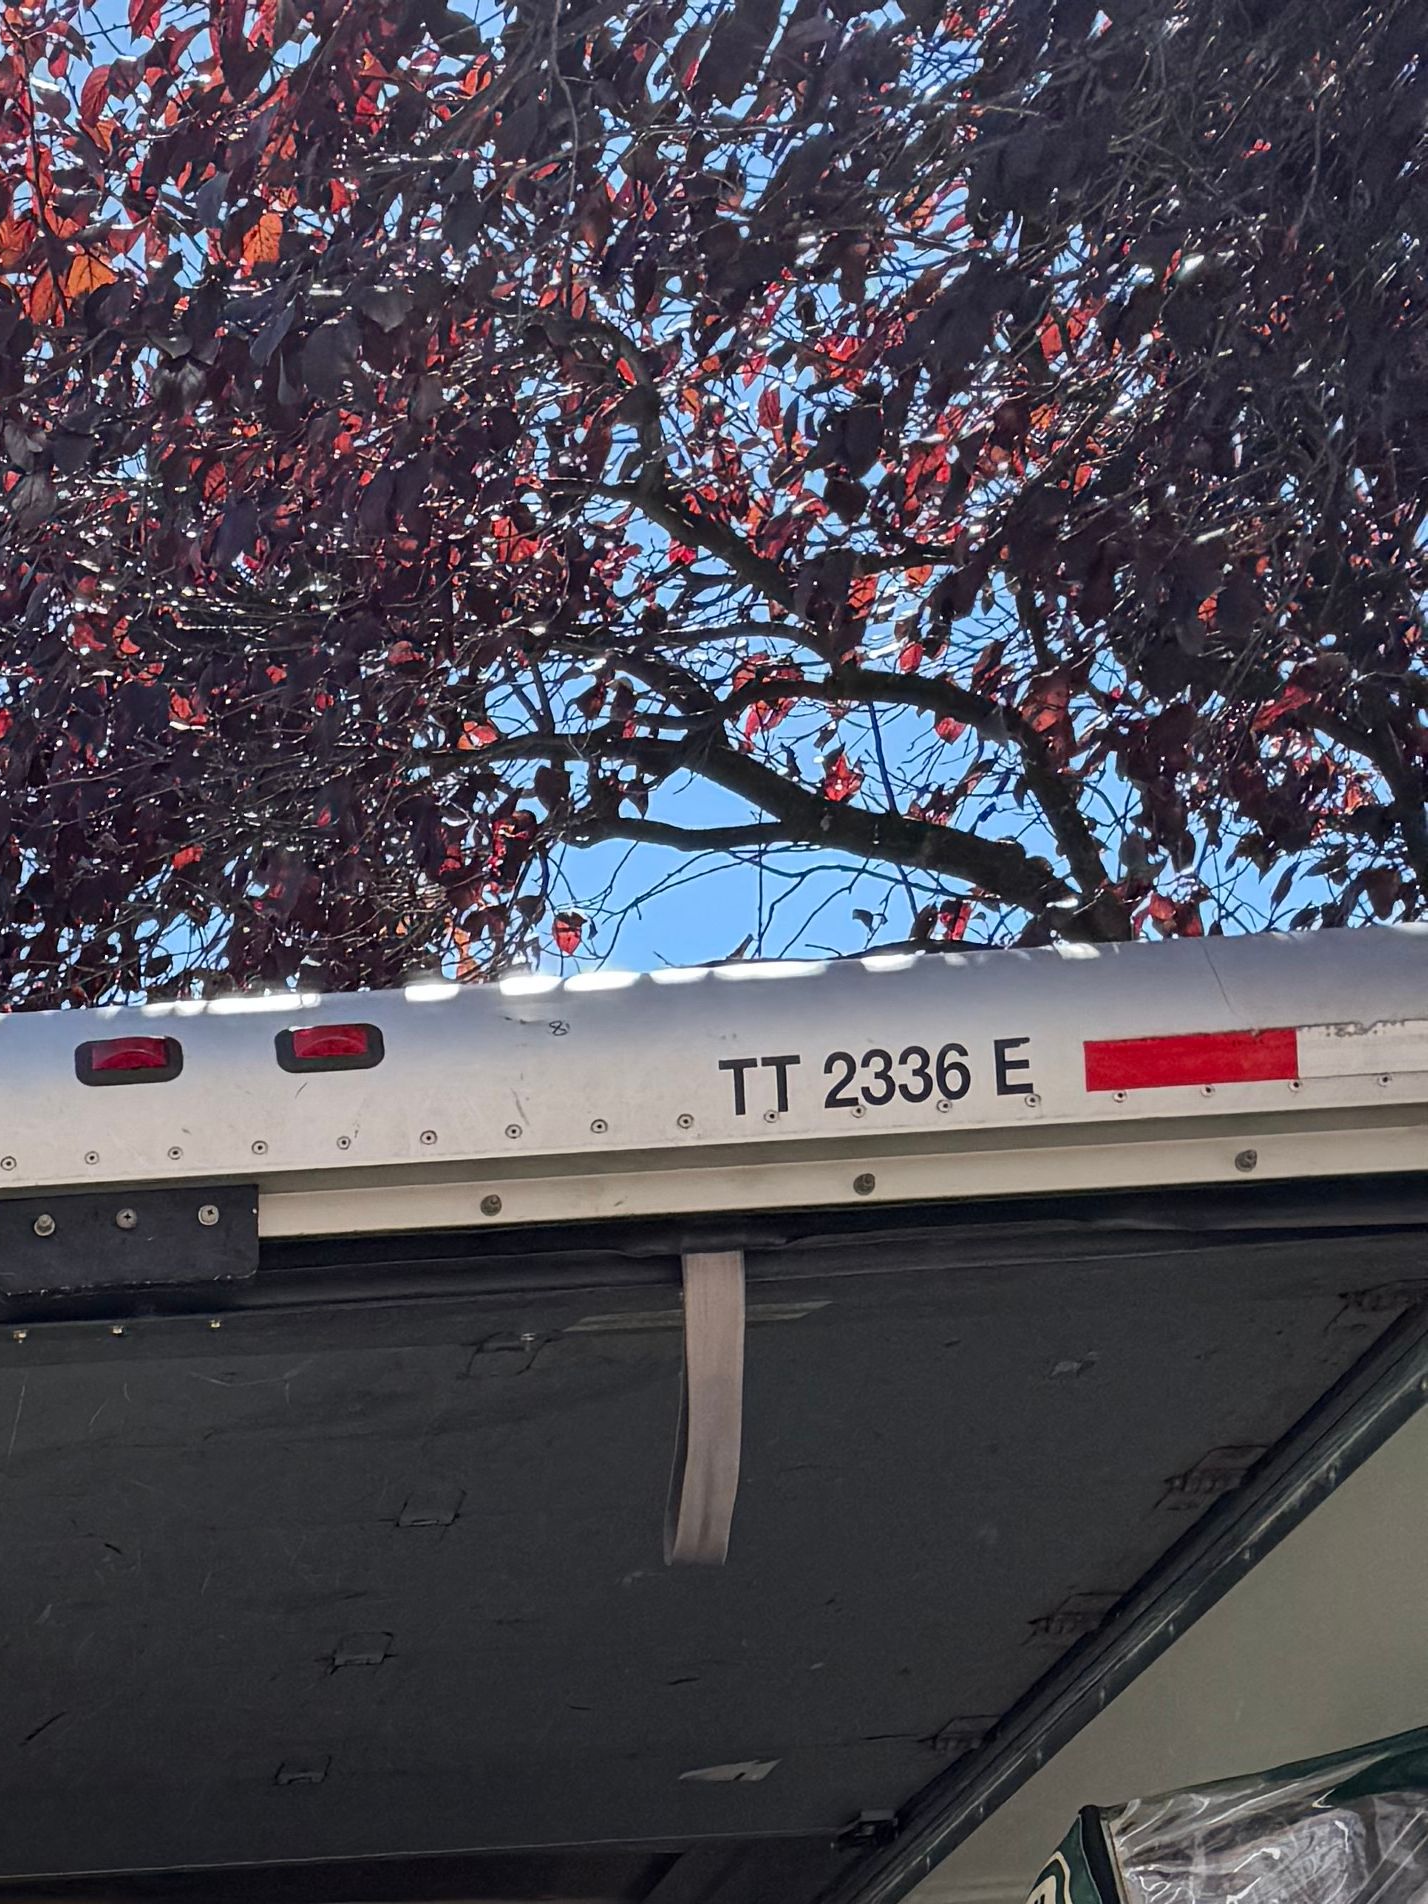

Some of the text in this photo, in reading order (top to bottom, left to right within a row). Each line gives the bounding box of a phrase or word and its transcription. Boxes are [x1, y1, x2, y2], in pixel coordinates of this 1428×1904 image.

[718, 1036, 1034, 1116] TT 2336 E
